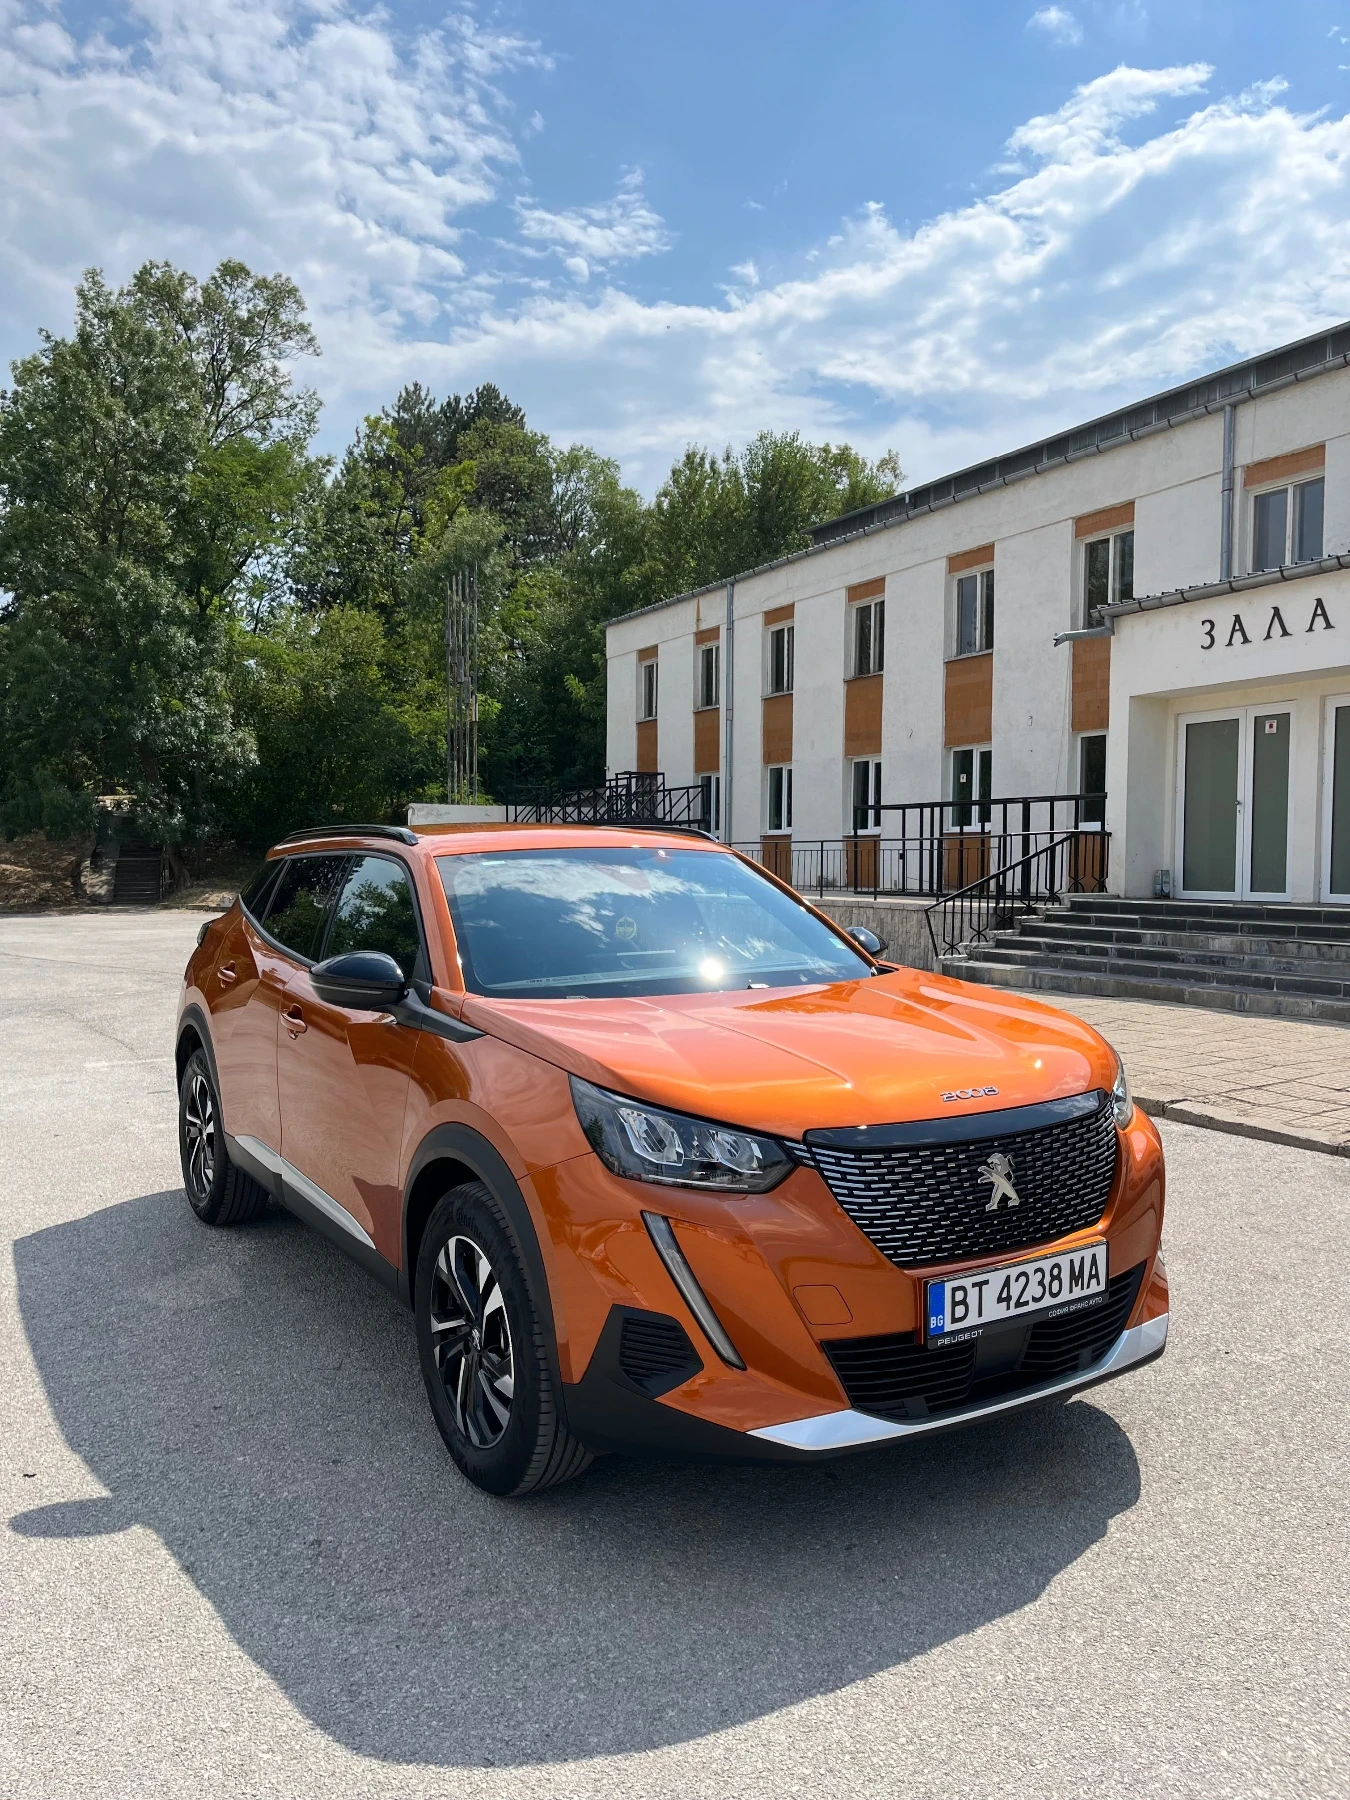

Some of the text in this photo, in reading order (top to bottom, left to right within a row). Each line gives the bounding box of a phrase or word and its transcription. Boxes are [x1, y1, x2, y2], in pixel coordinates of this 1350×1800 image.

[1201, 598, 1336, 650] ЗАЛА
[940, 1086, 999, 1102] 2008
[996, 1262, 1063, 1312] 4238
[930, 1315, 944, 1329] BG
[937, 1329, 984, 1346] PEUGEOT
